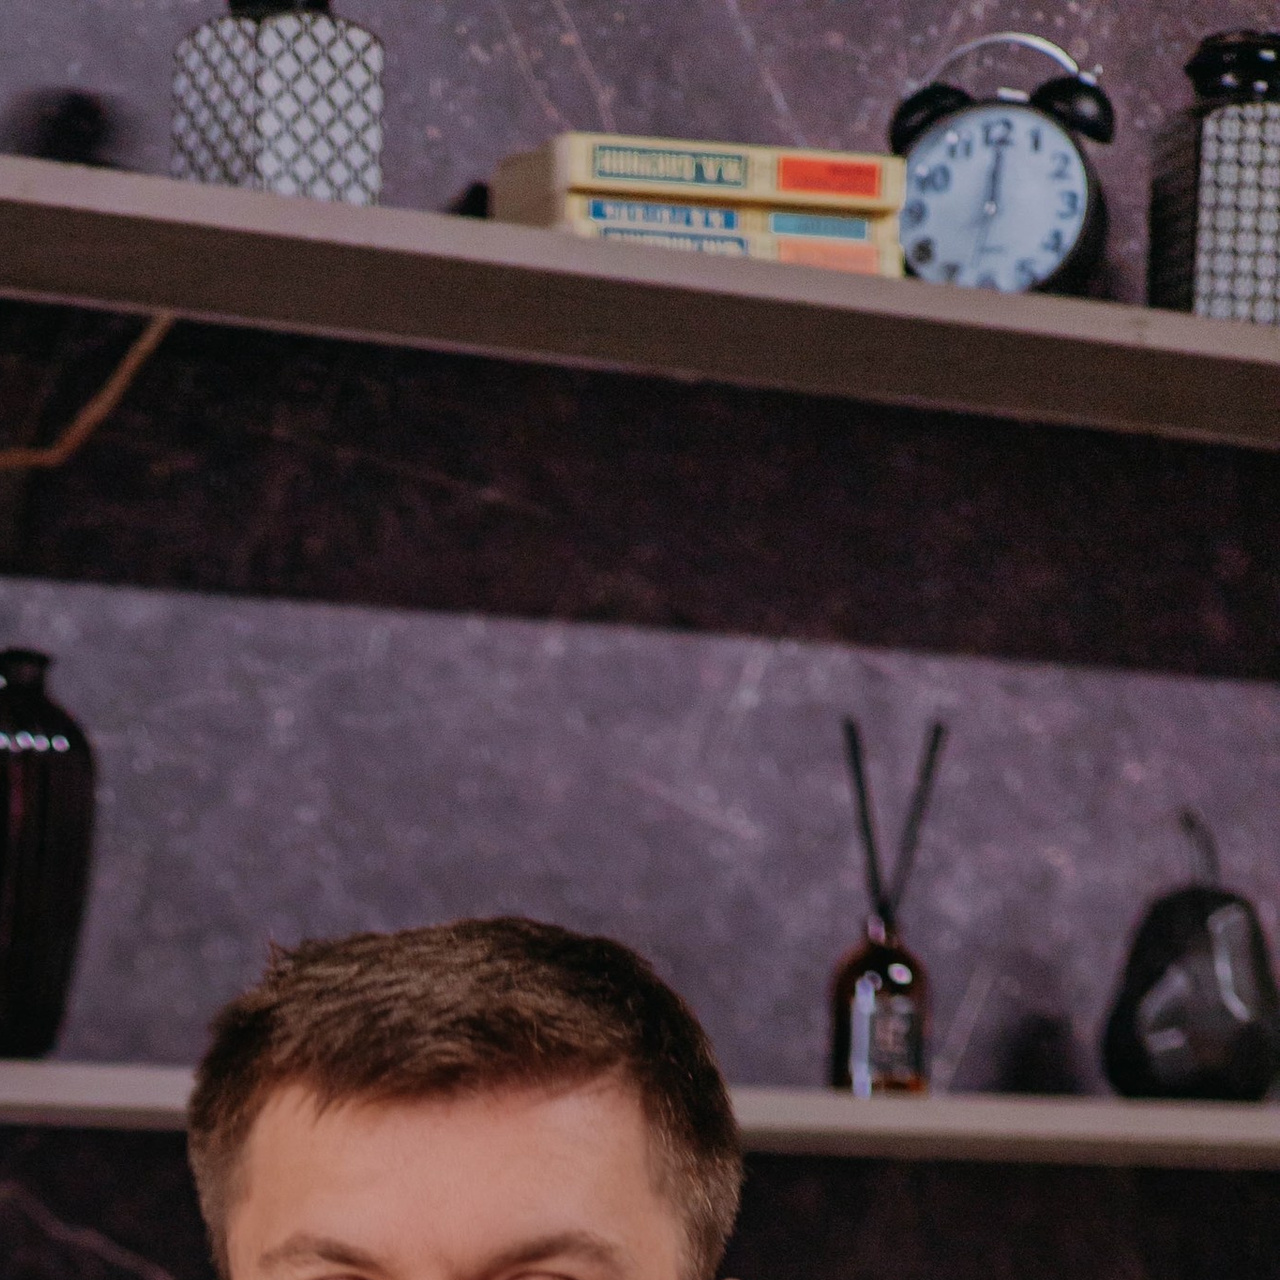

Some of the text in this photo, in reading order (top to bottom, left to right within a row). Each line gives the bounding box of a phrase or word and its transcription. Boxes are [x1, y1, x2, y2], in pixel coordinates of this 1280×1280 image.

[981, 117, 1014, 148] 12
[1030, 126, 1042, 153] 1
[1050, 152, 1070, 181] 2
[1057, 189, 1079, 221] 3
